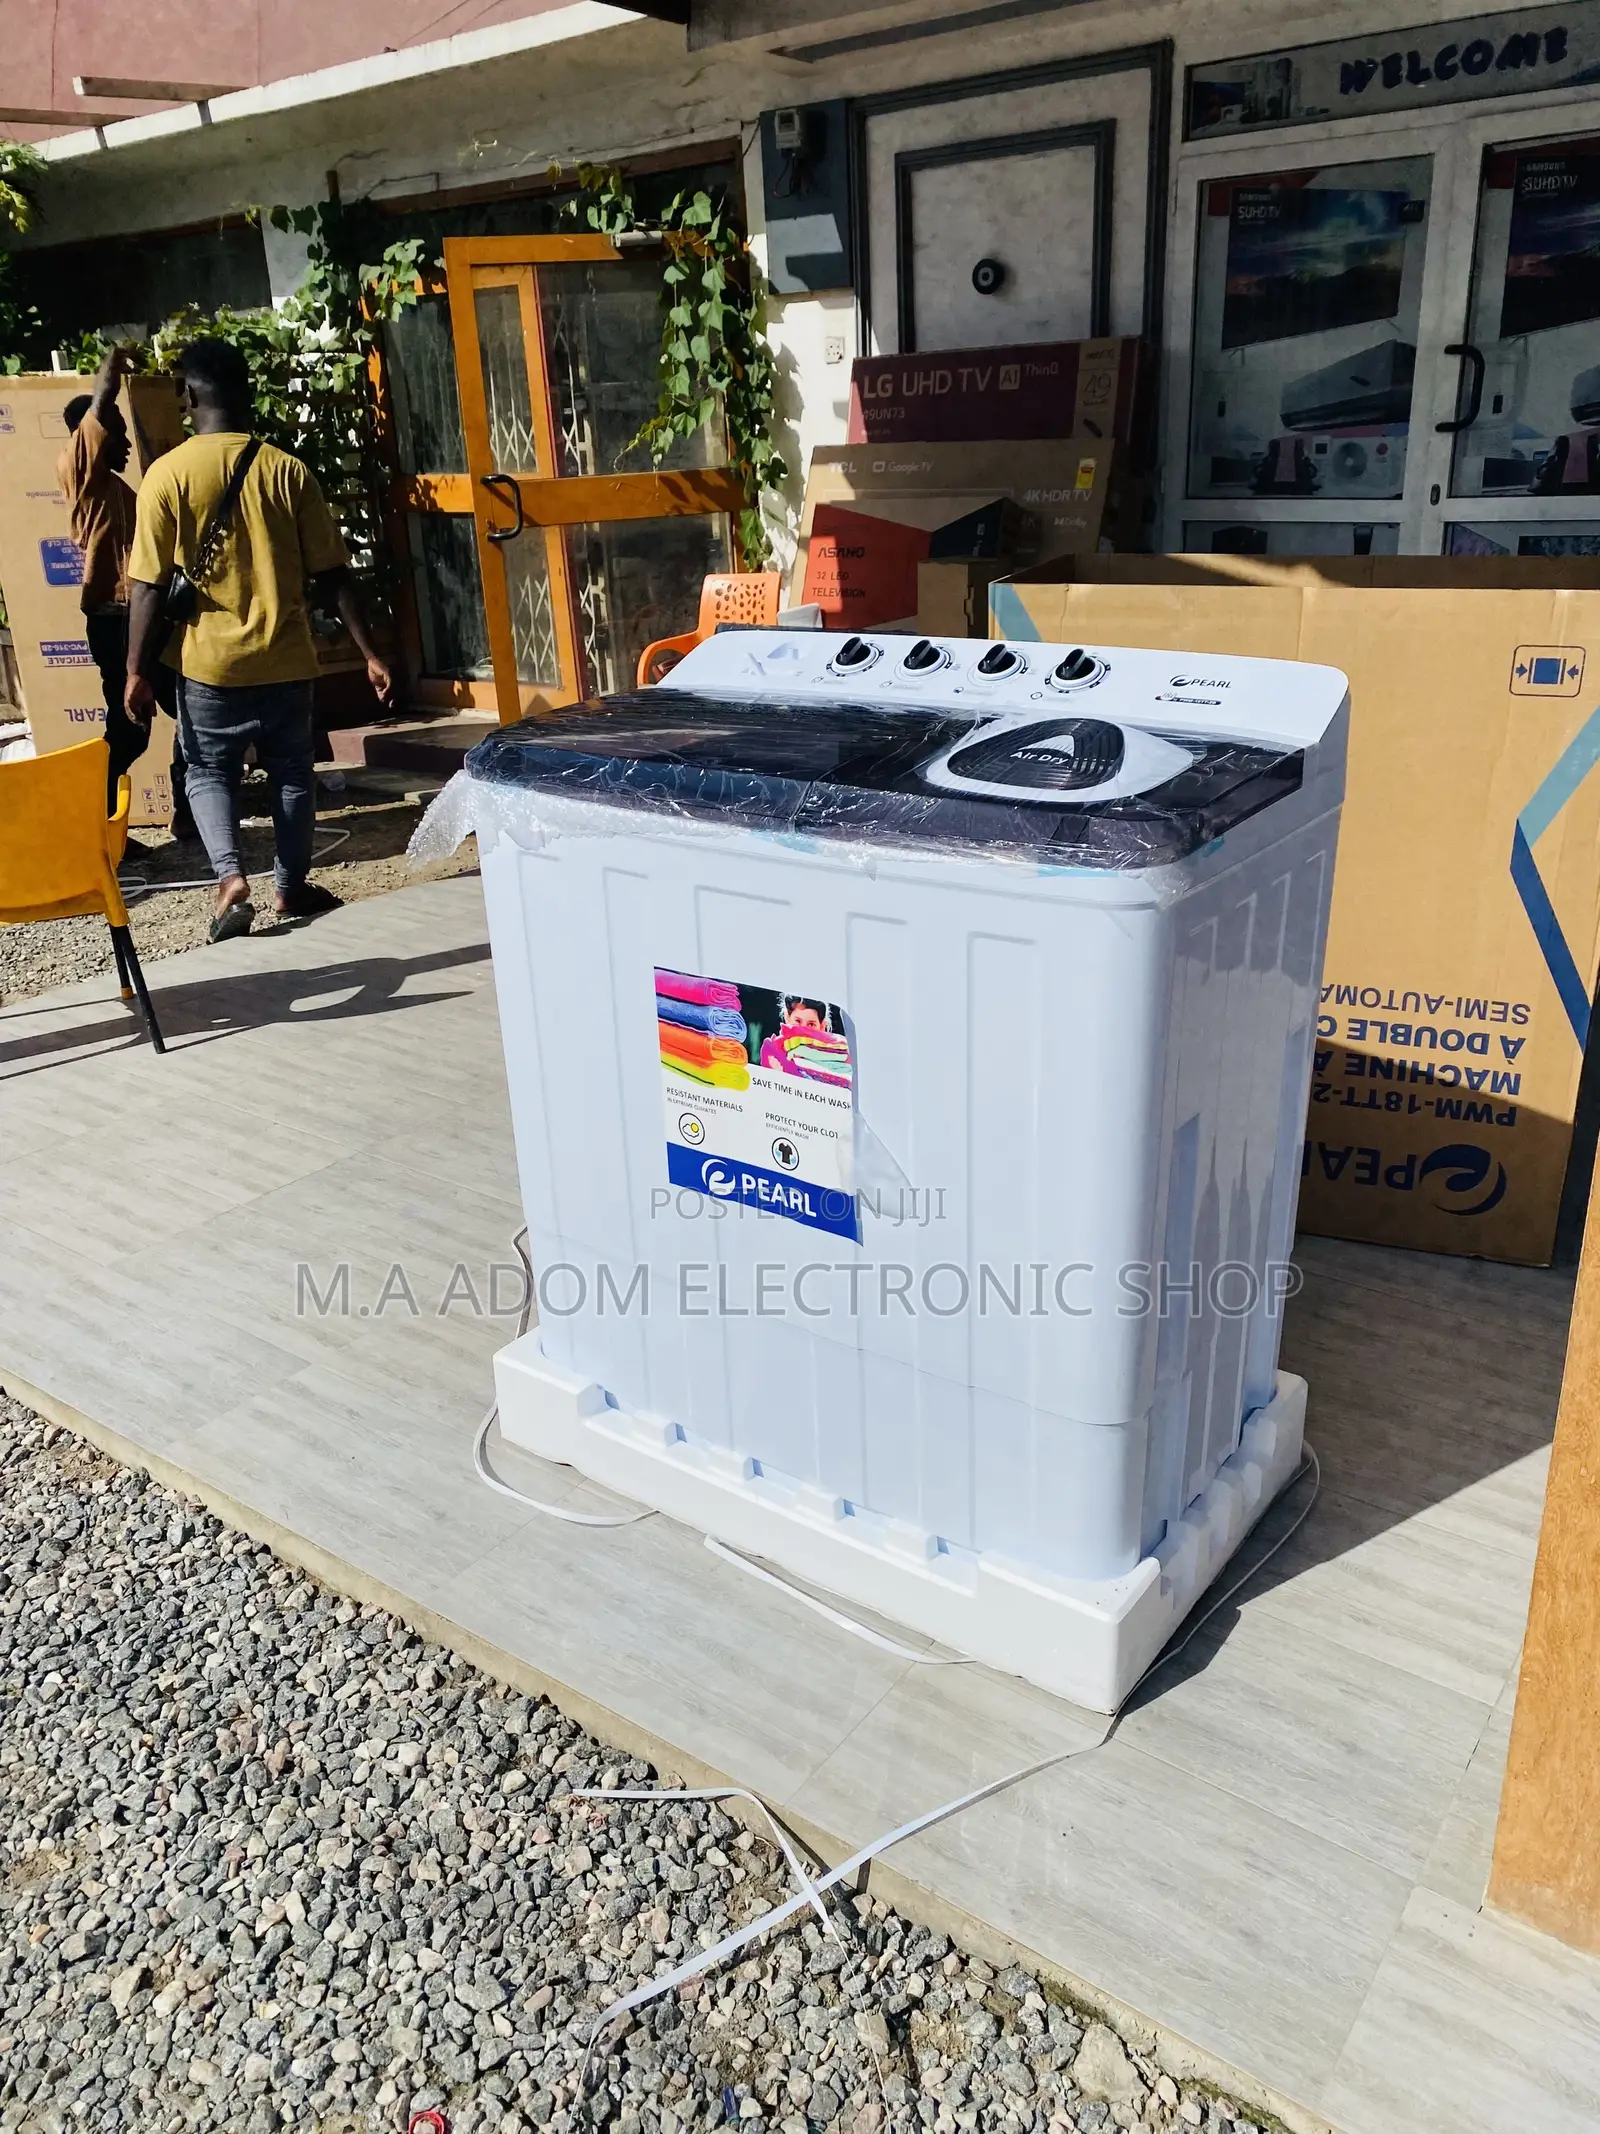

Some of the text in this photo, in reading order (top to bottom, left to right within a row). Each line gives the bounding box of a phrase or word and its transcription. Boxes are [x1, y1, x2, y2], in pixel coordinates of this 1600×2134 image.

[1340, 27, 1569, 95] WELCOME
[1562, 174, 1579, 189] TV
[863, 362, 1059, 399] LG UHD TV AI ThinQ
[828, 461, 857, 473] TCL
[888, 460, 934, 474] Google TV
[1023, 489, 1093, 502] 4K HDR TV
[818, 546, 865, 559] ASANO
[816, 571, 850, 581] 32 LED
[812, 587, 866, 599] TELEVISION
[1190, 677, 1232, 689] PEARL
[1010, 748, 1071, 770] Air Dry
[1346, 1018, 1491, 1056] DOUBLE
[1499, 1036, 1526, 1066] À
[1344, 1052, 1521, 1096] MACHINE
[666, 1087, 744, 1112] RESISTANT MATERIALS
[752, 1077, 772, 1089] SAVE
[774, 1082, 793, 1095] TIME
[795, 1089, 803, 1098] IN
[804, 1091, 826, 1104] EACH
[673, 1098, 694, 1109] EXTREME
[693, 1104, 717, 1115] CLIMATES
[765, 1112, 797, 1126] PROTECT
[798, 1121, 819, 1134] YOUR
[1301, 1140, 1418, 1191] PEA
[741, 1173, 817, 1218] PEARL
